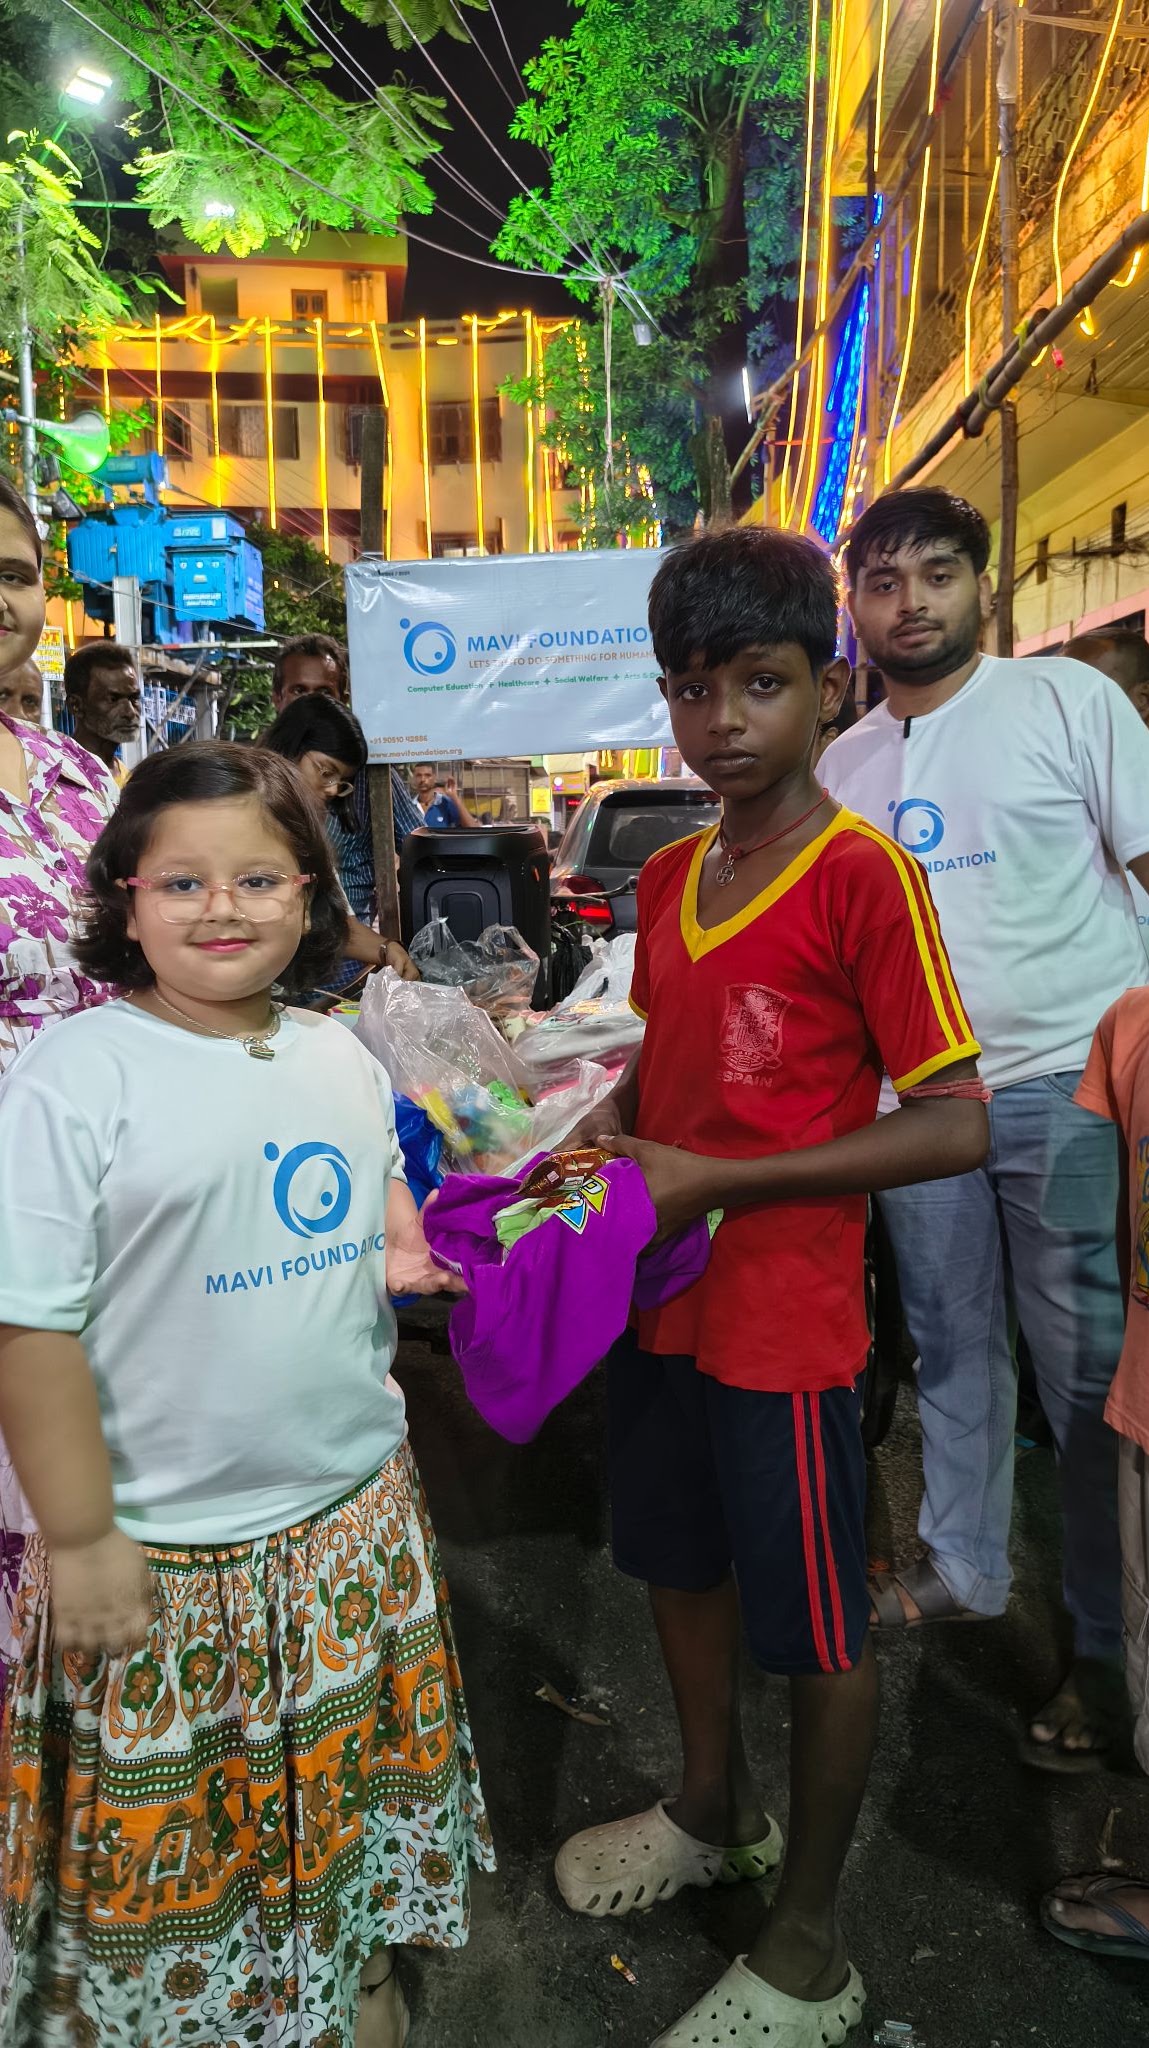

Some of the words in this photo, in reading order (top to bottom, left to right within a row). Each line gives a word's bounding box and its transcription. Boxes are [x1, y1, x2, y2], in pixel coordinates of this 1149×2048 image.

[468, 634, 519, 652] MAVI
[529, 626, 653, 649] FOUNDATIO
[528, 656, 542, 665] DO
[545, 653, 597, 665] SOMETHING
[599, 652, 617, 661] FOR
[407, 685, 445, 694] Computer
[445, 682, 483, 691] Education
[498, 679, 540, 689] Healthcare
[554, 676, 577, 684] Social
[579, 674, 609, 683] Welfare
[369, 747, 463, 758] www.mavifoundation.org
[925, 850, 997, 874] NDATION
[722, 1070, 773, 1087] SPAIN
[205, 1265, 273, 1295] MAVI
[281, 1232, 386, 1281] FOUNDATIO
